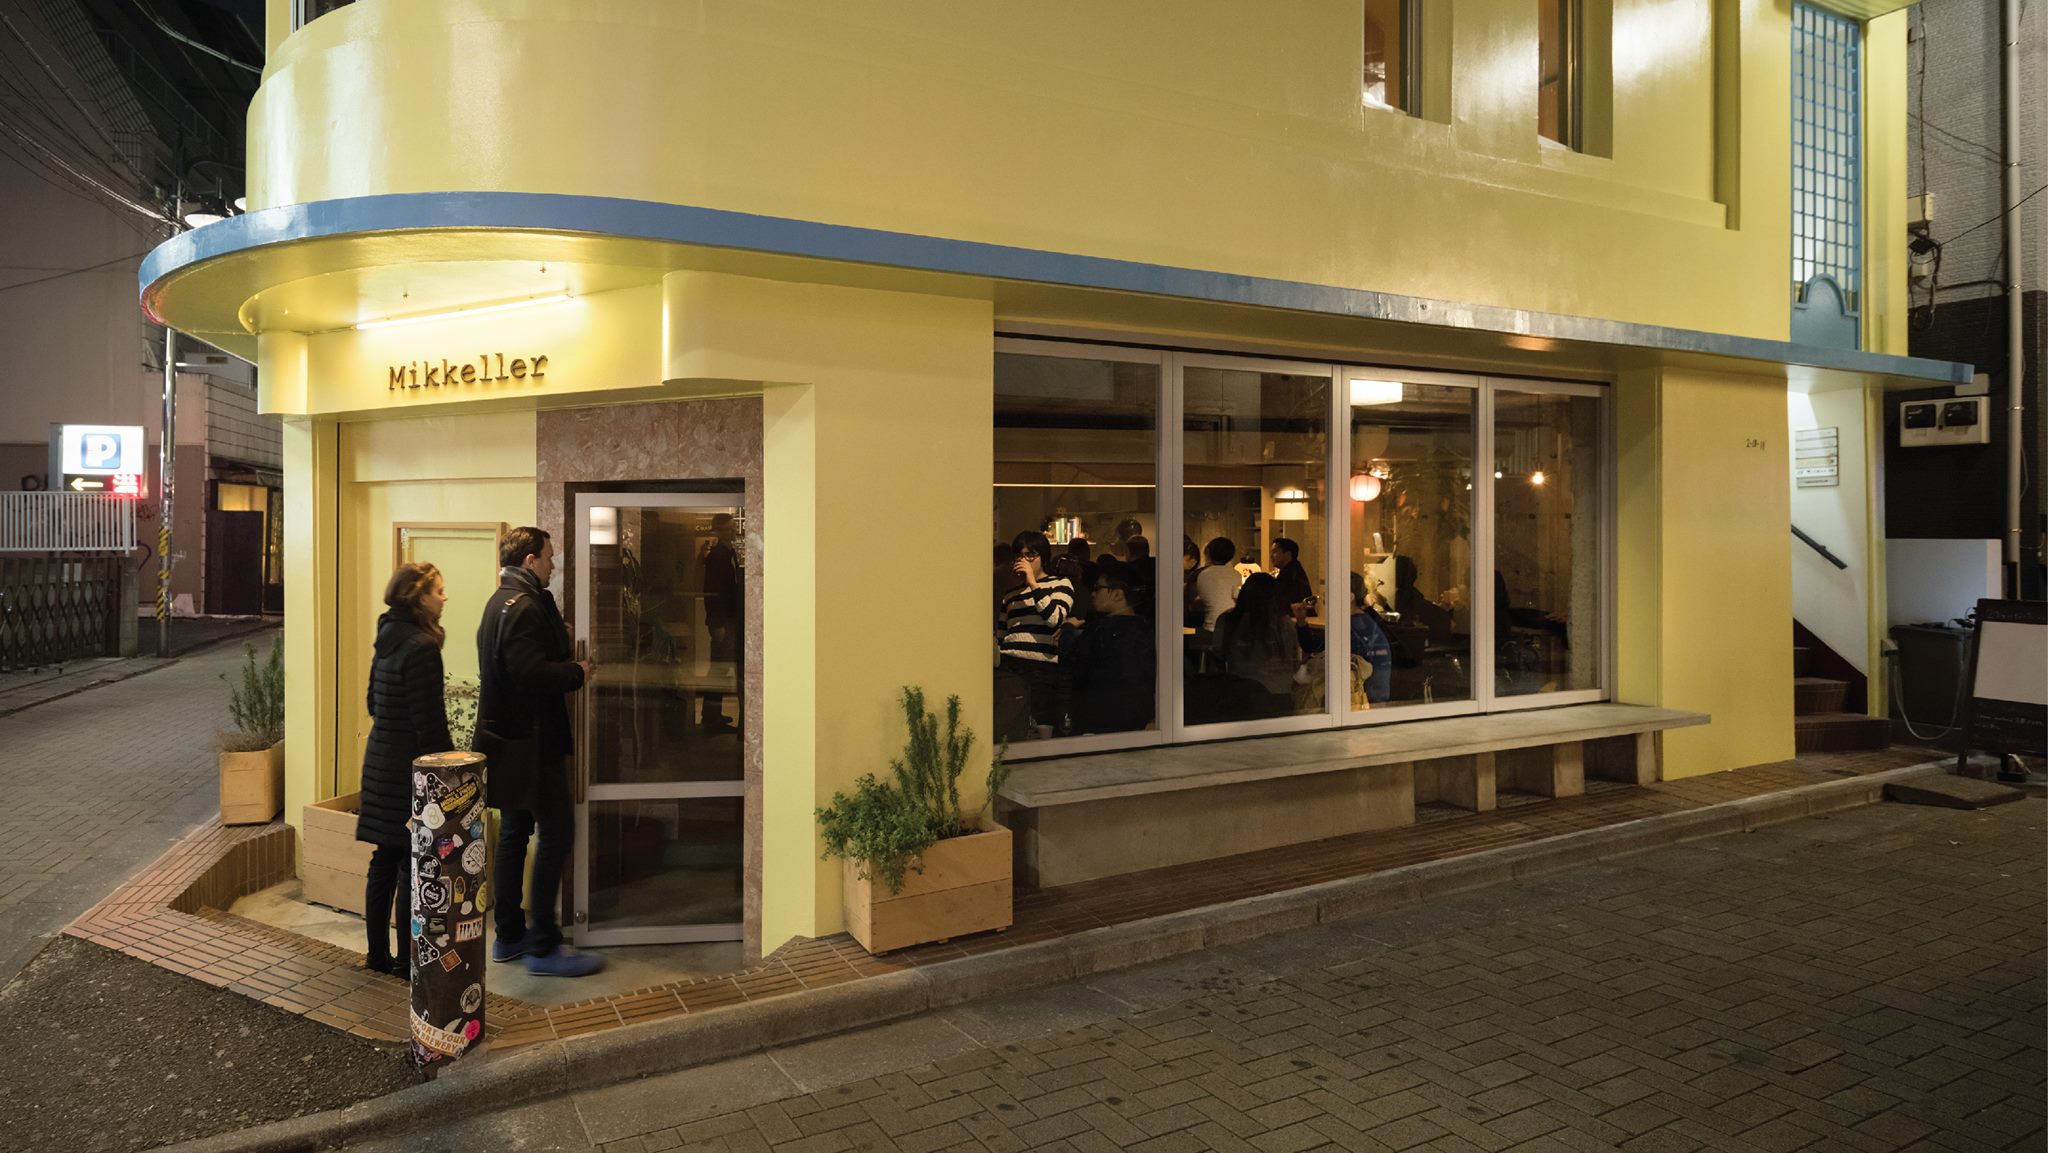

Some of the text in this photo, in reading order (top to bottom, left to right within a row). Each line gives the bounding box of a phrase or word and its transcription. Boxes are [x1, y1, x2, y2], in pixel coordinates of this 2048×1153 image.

[389, 352, 548, 390] Mikkeller
[86, 435, 117, 466] P
[420, 1032, 458, 1052] BREWERY
[441, 1032, 466, 1045] YOUR
